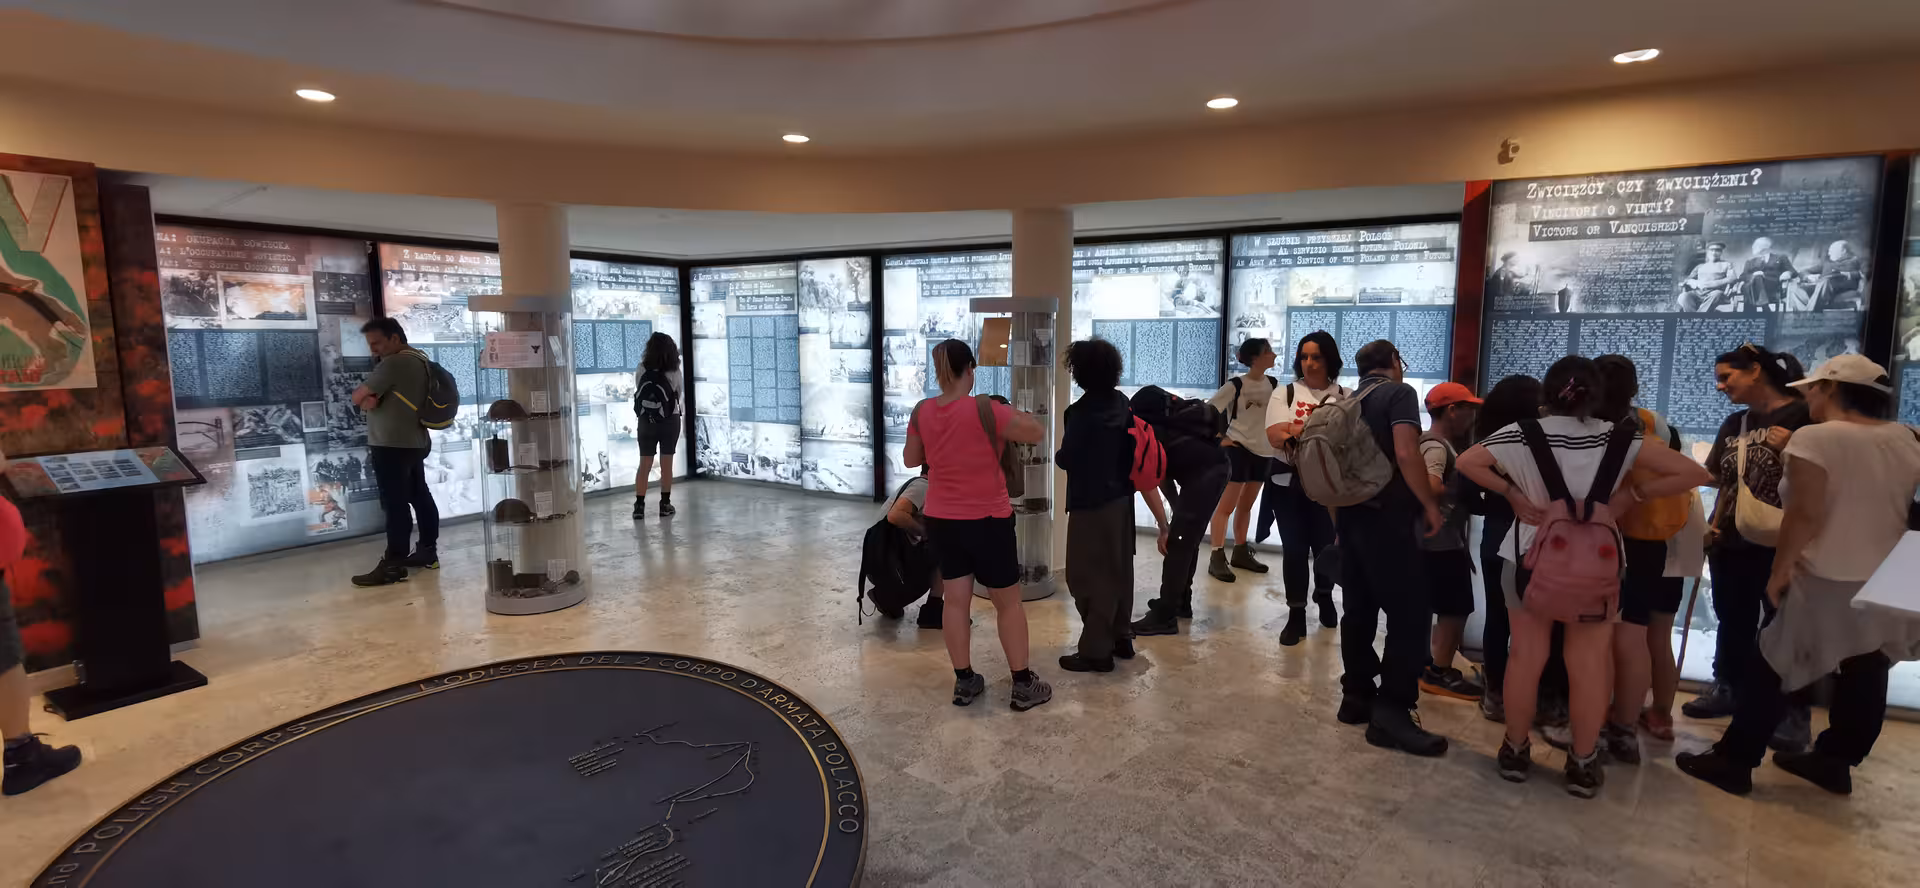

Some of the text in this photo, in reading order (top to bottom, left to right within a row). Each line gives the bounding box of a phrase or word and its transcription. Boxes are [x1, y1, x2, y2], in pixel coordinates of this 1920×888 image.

[1527, 168, 1763, 199] ZWYCIĘZCY CZY ZWYCIĘŻENI?
[1532, 199, 1674, 219] VINCITORI O VINTI?
[1533, 218, 1688, 238] VICTORS OR VANQUISHED?
[1254, 237, 1261, 247] W
[1359, 231, 1393, 242] POLSCE
[1278, 247, 1289, 256] AL
[1293, 246, 1327, 255] SERVIZIO
[1360, 244, 1387, 252] FUTURA
[1393, 241, 1428, 251] POLONIA
[1249, 258, 1265, 267] ARMY
[1269, 258, 1277, 266] AT
[1281, 257, 1293, 265] THE
[1297, 255, 1325, 265] SERVICE
[1329, 256, 1338, 264] OF
[1360, 254, 1386, 263] POLAND
[1391, 254, 1400, 262] OF
[1405, 253, 1418, 261] THE
[1424, 251, 1451, 260] FUTURE
[419, 657, 566, 692] L'ODISSEA
[579, 655, 625, 665] DEL
[659, 657, 737, 681] CORPO
[740, 678, 827, 740] D'ARMATA
[819, 742, 859, 835] POLACCO
[73, 780, 190, 854] POLISH
[195, 722, 308, 776] CORPS
